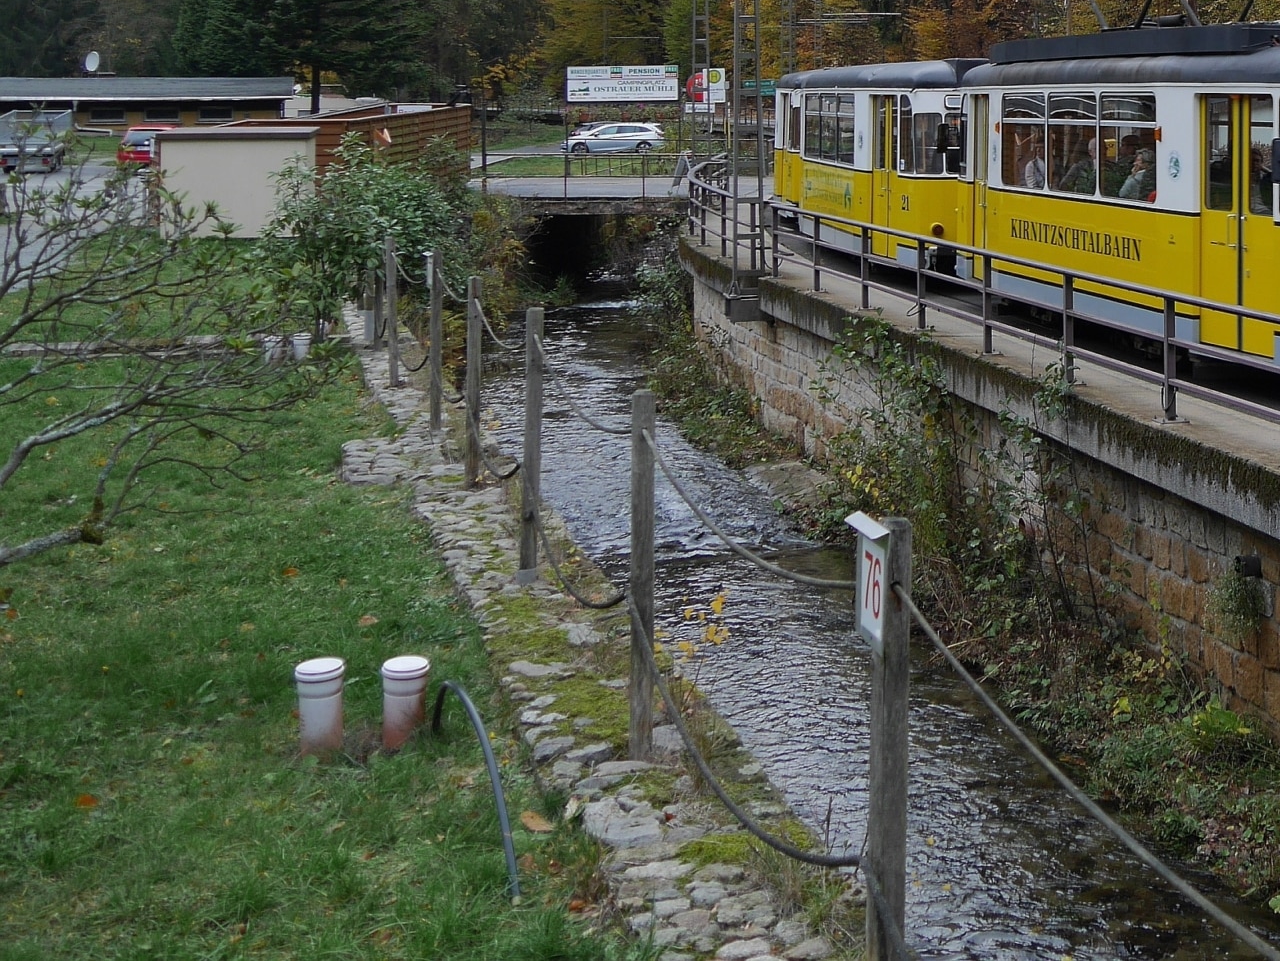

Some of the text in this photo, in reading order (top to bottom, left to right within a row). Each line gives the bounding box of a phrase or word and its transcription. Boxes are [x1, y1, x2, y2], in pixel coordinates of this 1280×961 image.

[901, 194, 910, 211] 21
[1010, 218, 1142, 262] KIRNITZSCHTALBAHN
[864, 550, 882, 620] 76
